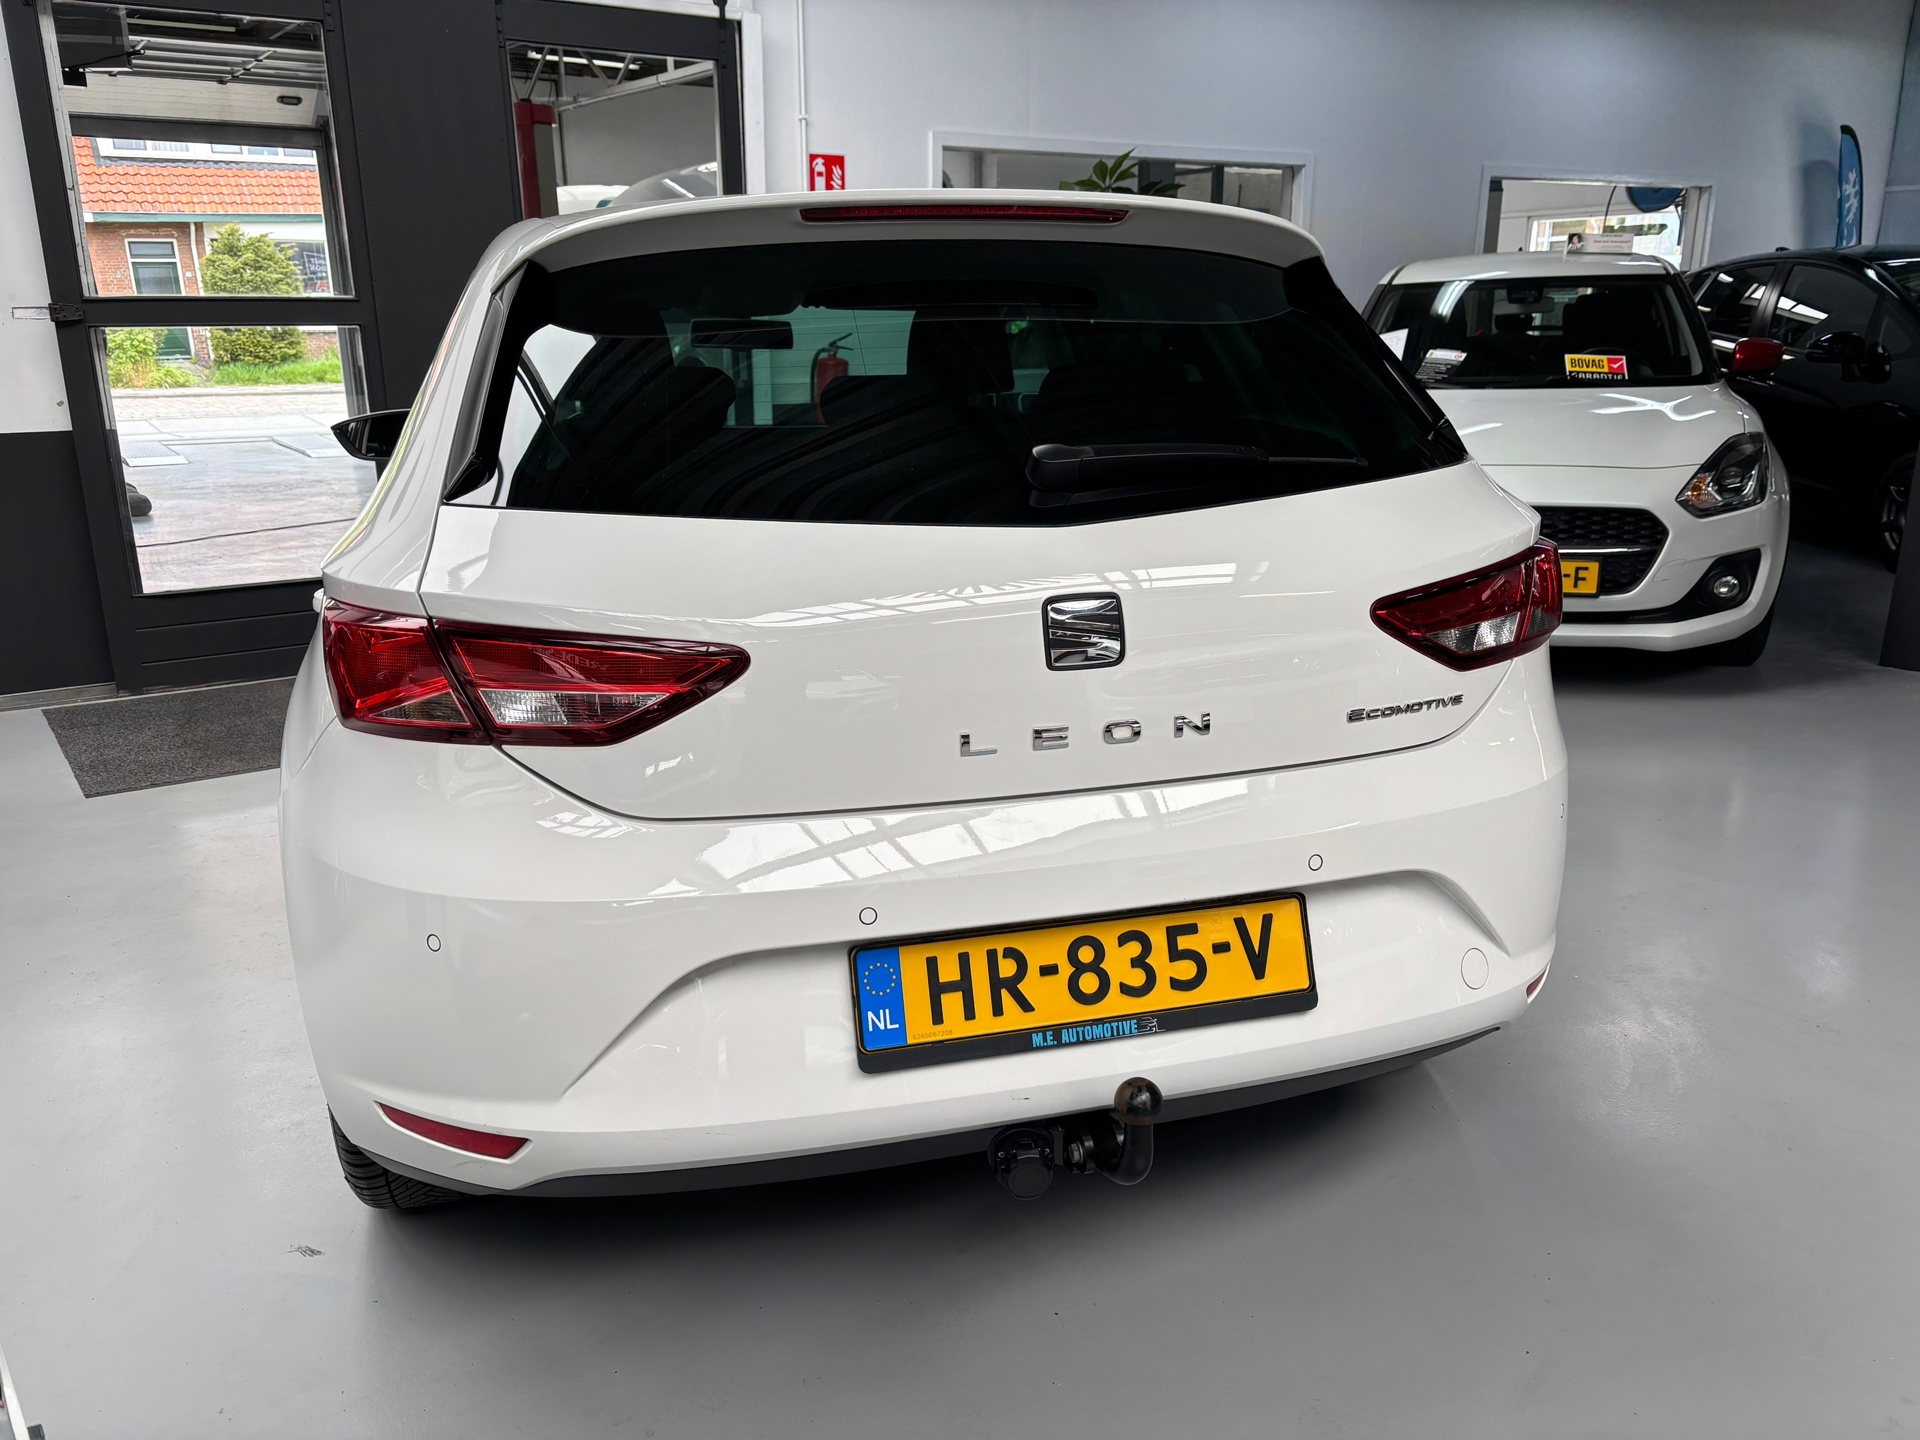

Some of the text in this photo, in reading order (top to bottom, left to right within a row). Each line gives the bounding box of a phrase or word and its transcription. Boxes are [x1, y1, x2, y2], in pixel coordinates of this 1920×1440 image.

[1570, 358, 1605, 369] BOVAG
[1563, 566, 1589, 588] -F
[960, 713, 1211, 757] LEON
[926, 913, 1274, 1026] HR-835-V
[867, 1008, 900, 1032] NL
[1031, 1019, 1138, 1048] M.E. AUTOMOTIVE
